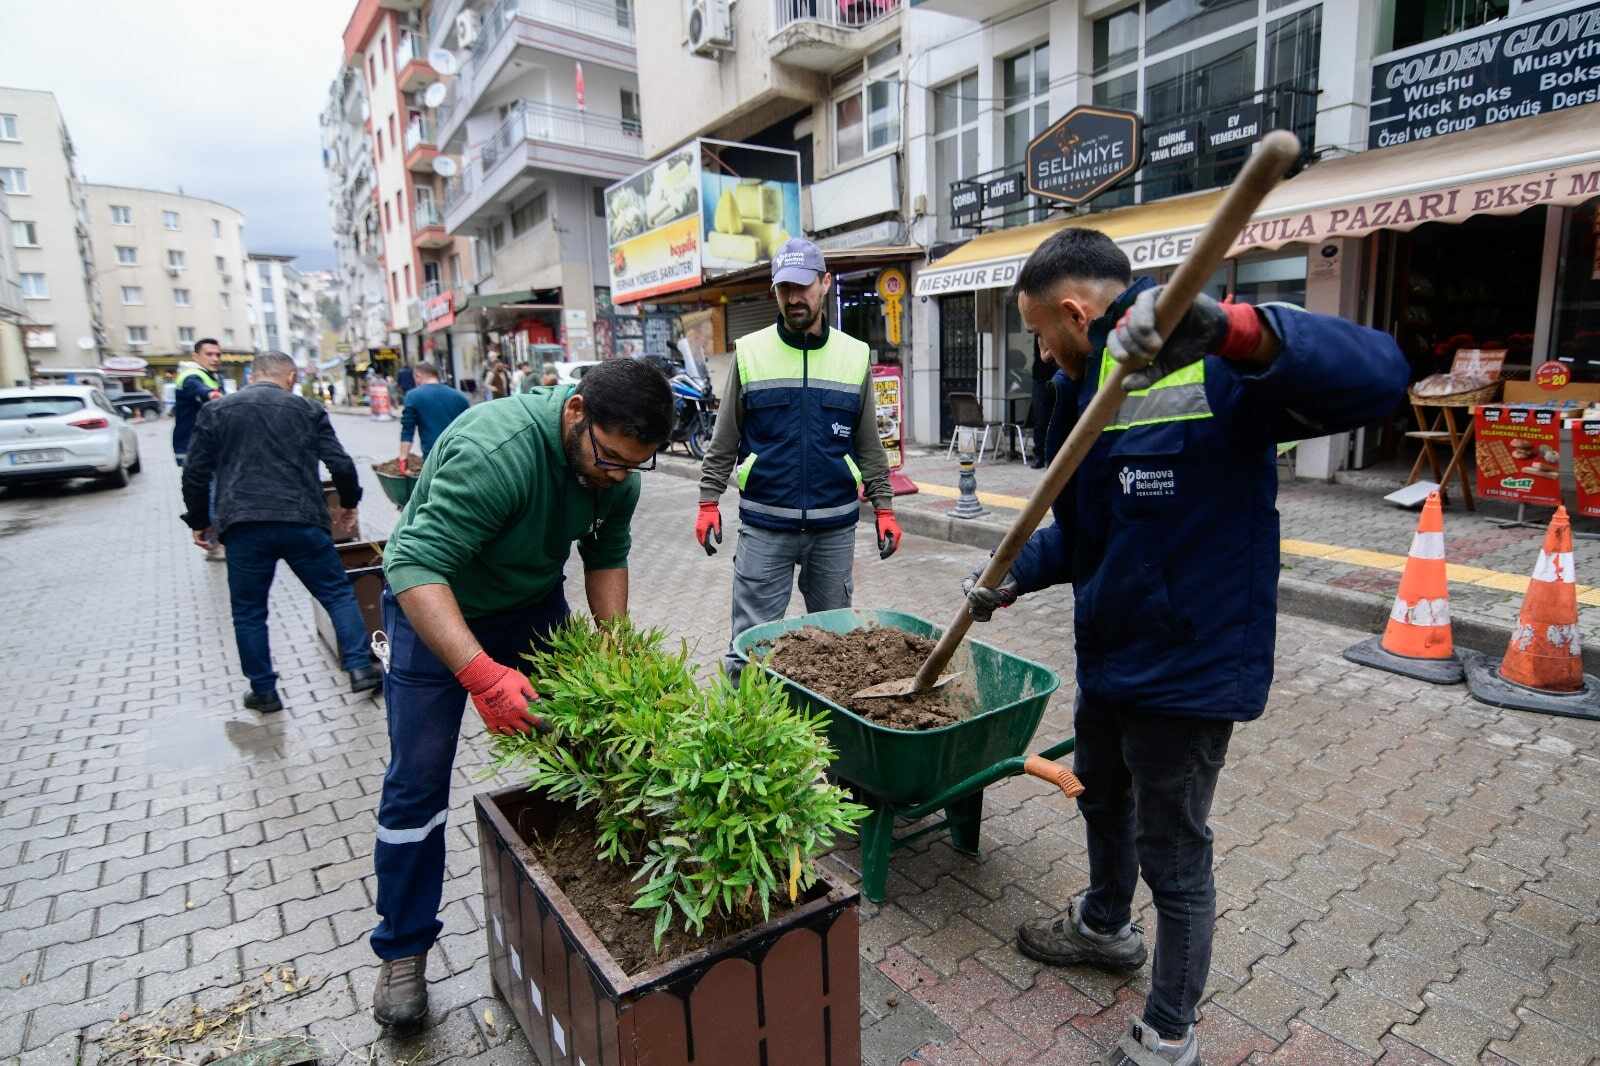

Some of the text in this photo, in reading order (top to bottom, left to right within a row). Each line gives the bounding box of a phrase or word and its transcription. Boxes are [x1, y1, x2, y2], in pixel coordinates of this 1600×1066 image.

[1386, 36, 1501, 89] GOLDEN
[1403, 73, 1474, 103] Wushu
[1539, 65, 1600, 91] Boks
[1408, 86, 1512, 122] Kick boks
[1228, 114, 1240, 127] EV
[1378, 126, 1410, 147] Özel
[1414, 125, 1432, 138] ve
[1436, 115, 1476, 137] Grup
[1485, 99, 1541, 124] Dövüş
[1158, 130, 1187, 147] EDİRNE
[1210, 121, 1257, 146] YEMEKLERİ
[1038, 140, 1124, 177] SELİMİYE
[1150, 151, 1169, 162] TAVA
[1070, 168, 1091, 180] TAVA
[952, 180, 1015, 211] ÇORBA KÖFTE
[1238, 215, 1315, 246] KULA
[1327, 190, 1461, 233] PAZARI
[1471, 173, 1557, 206] EKŞİ
[919, 270, 987, 292] MEŞHUR
[1551, 374, 1566, 386] 20
[1136, 469, 1173, 480] Bornova
[1136, 479, 1174, 490] Belediyesi
